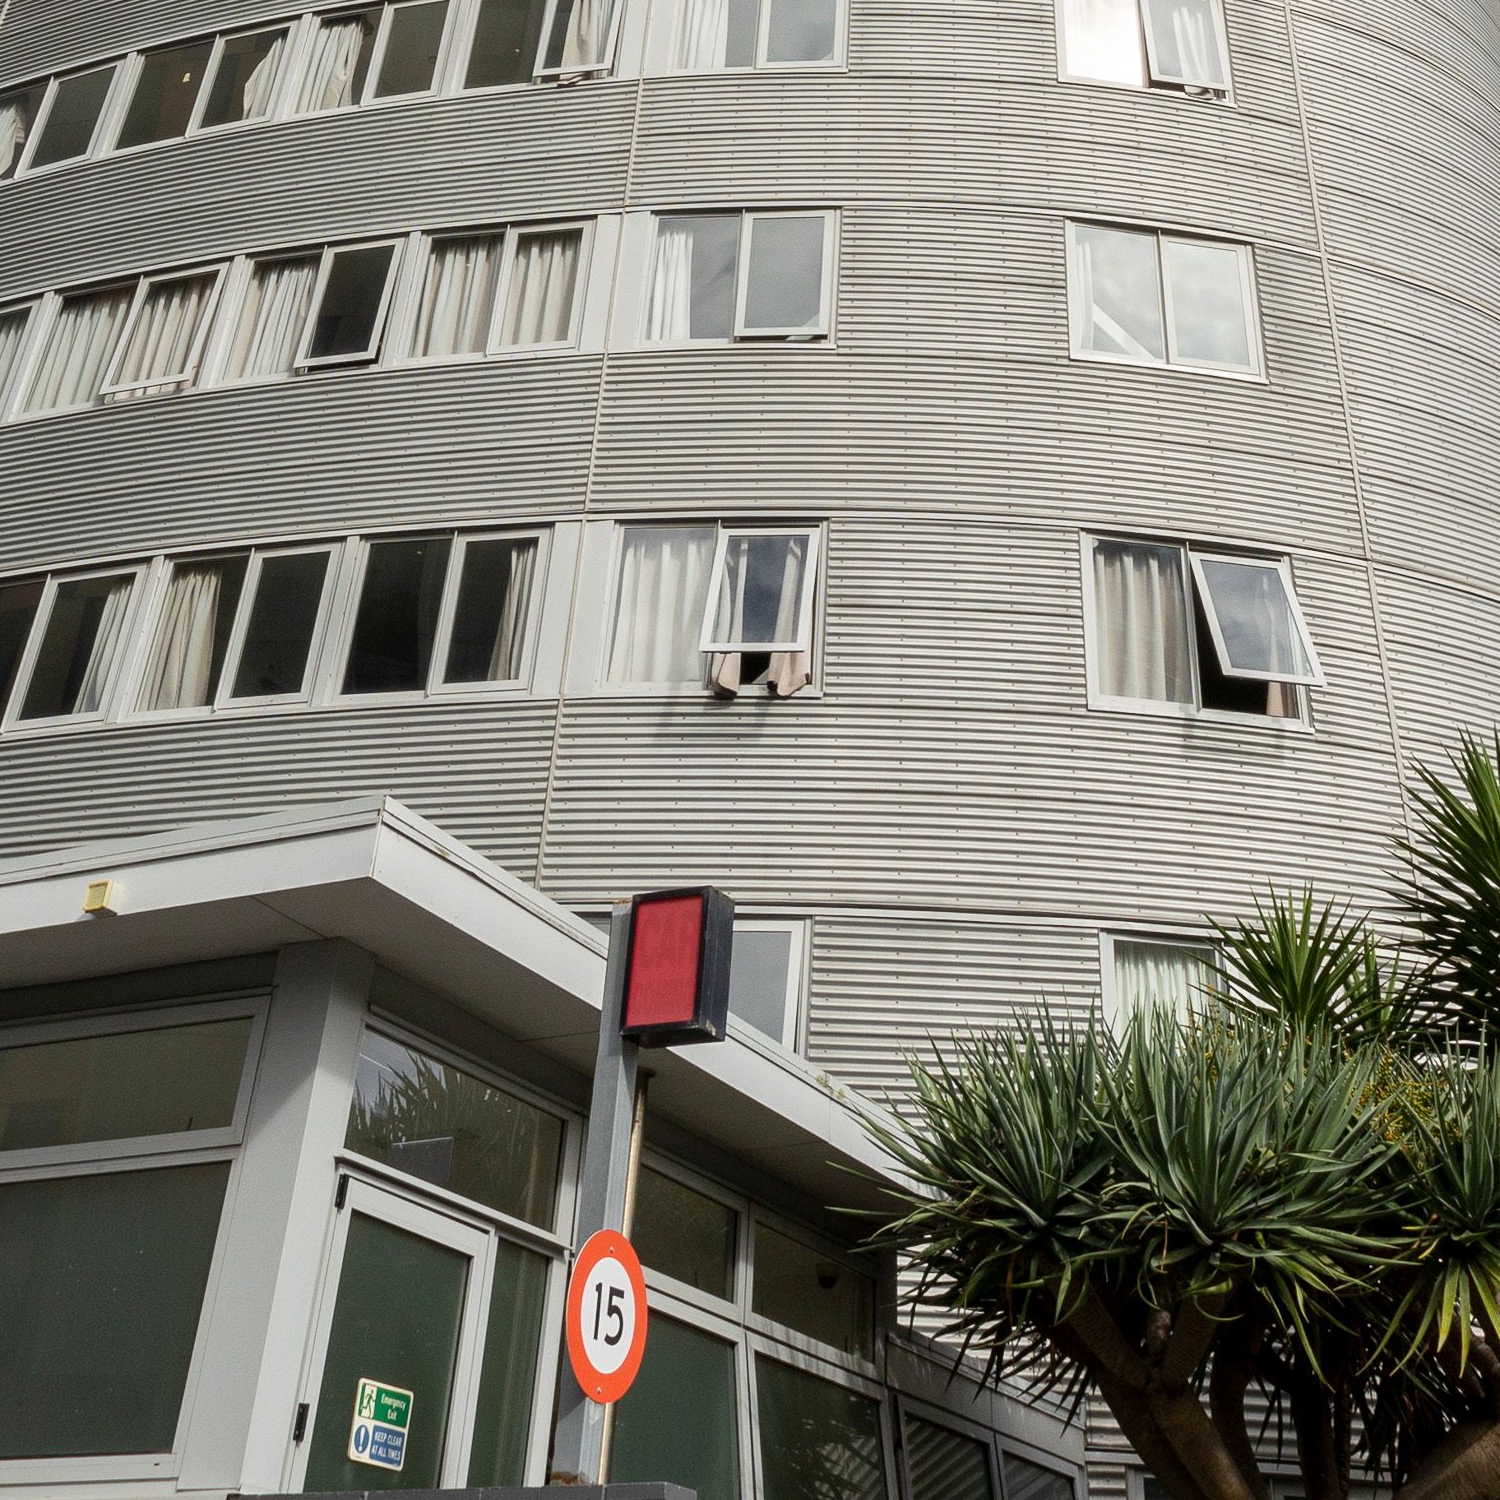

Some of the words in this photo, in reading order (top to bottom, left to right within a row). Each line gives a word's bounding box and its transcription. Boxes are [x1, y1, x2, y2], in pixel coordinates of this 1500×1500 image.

[593, 1281, 625, 1346] 15
[381, 1393, 406, 1411] Emergency
[387, 1409, 397, 1420] Exit
[374, 1431, 387, 1442] KEEP
[387, 1435, 402, 1447] CLEAR
[371, 1445, 378, 1454] AT
[377, 1446, 387, 1457] ALL
[387, 1448, 401, 1460] TIMES
